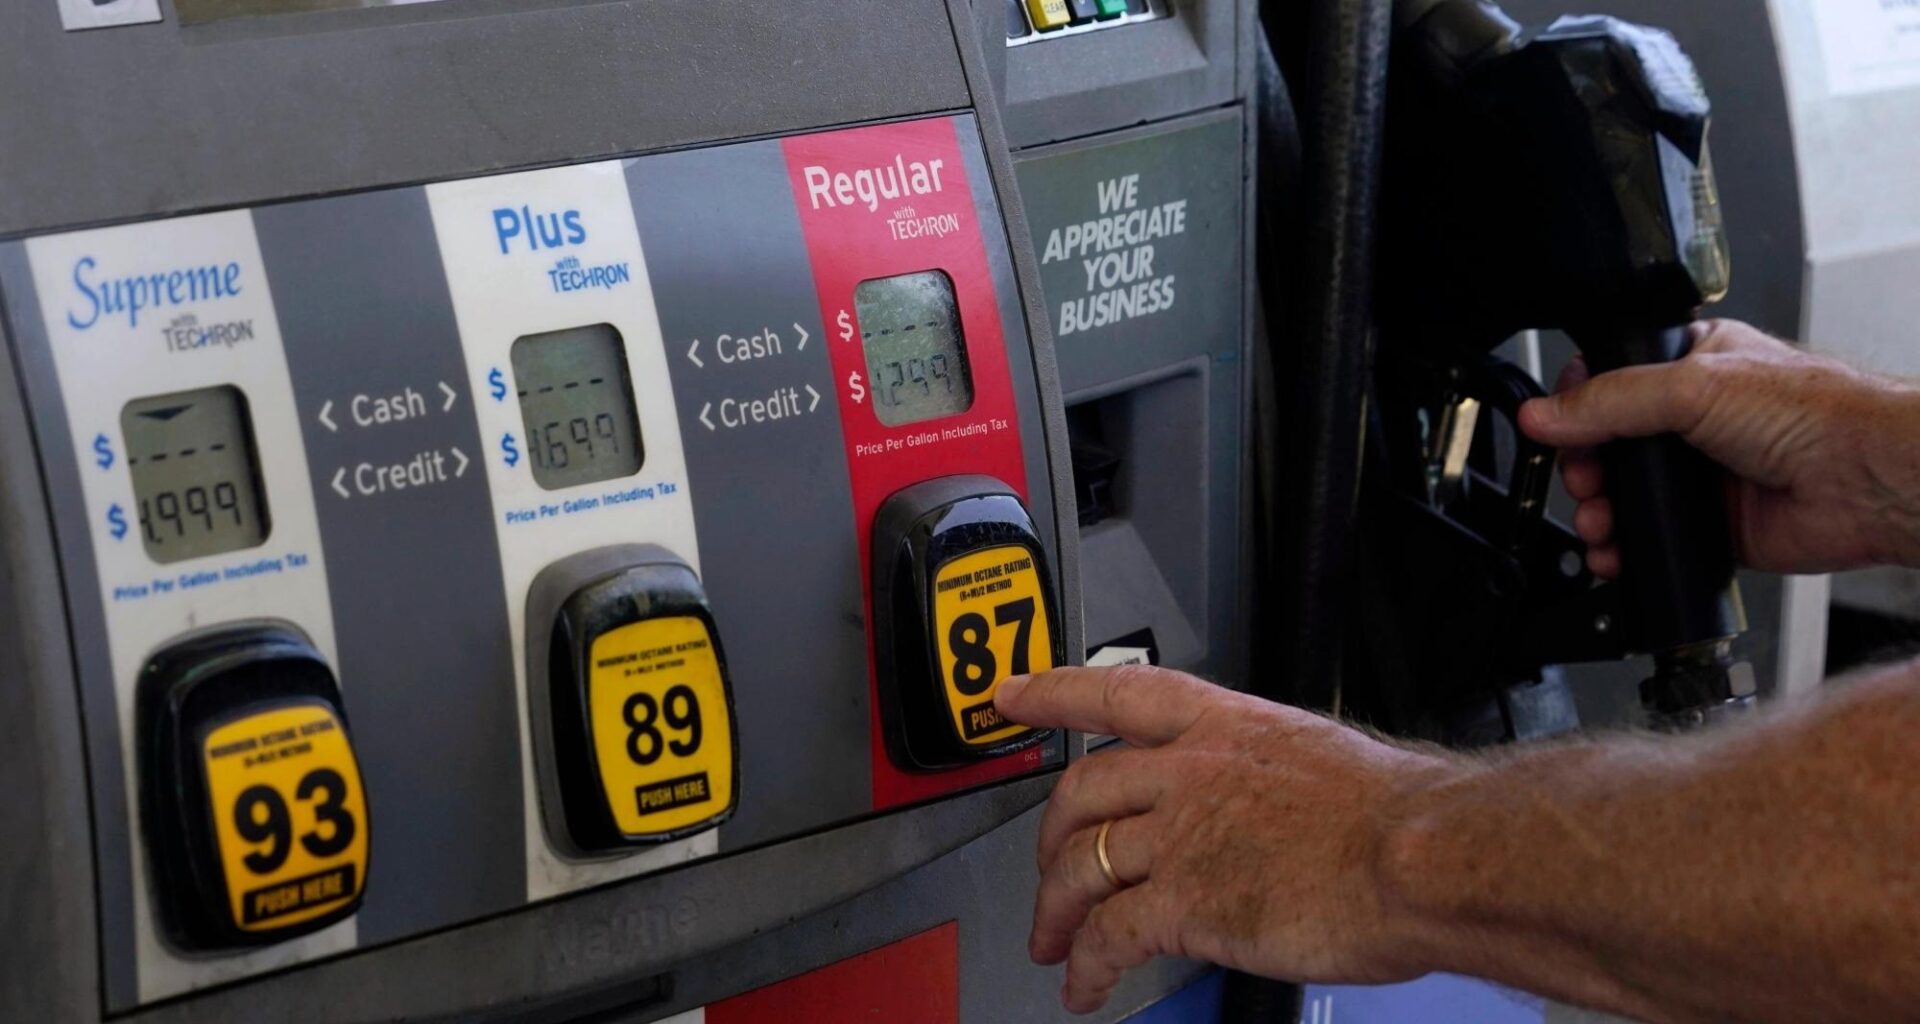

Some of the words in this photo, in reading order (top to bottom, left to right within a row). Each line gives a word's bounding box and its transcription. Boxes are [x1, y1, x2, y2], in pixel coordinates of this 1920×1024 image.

[803, 153, 944, 213] Regular
[1097, 173, 1140, 215] WE
[493, 205, 587, 255] Plus
[887, 212, 960, 241] TECHRON
[894, 206, 917, 220] with
[1041, 199, 1188, 265] APPRECIATE
[548, 263, 630, 293] TECHRON
[555, 256, 581, 271] with
[1082, 245, 1155, 292] YOUR
[68, 256, 242, 330] Supreme
[1058, 275, 1175, 336] BUSINESS
[162, 319, 255, 353] TECHRON
[837, 309, 854, 342] $
[717, 327, 783, 364] Cash
[488, 367, 507, 402] $
[848, 370, 865, 404] $
[351, 388, 427, 427] Cash
[720, 386, 801, 429] Credit
[93, 433, 114, 470] $
[501, 433, 519, 467] $
[856, 441, 884, 457] Price
[886, 437, 904, 452] Per
[906, 431, 939, 449] Gallon
[941, 422, 988, 441] Including
[990, 418, 1009, 431] Tax
[354, 451, 448, 495] Credit
[107, 503, 129, 542] $
[506, 509, 537, 524] Price
[540, 503, 560, 518] Per
[563, 496, 600, 513] Gallon
[602, 485, 654, 507] Including
[657, 482, 676, 495] Tax
[114, 585, 149, 601] Price
[153, 578, 175, 593] Per
[179, 569, 221, 588] Gallon
[224, 557, 283, 580] Including
[286, 552, 309, 567] Tax
[937, 573, 972, 593] MINIMUM
[974, 565, 1002, 583] OCTANE
[1004, 557, 1031, 576] RATING
[987, 578, 1012, 594] METHOD
[949, 597, 1035, 695] 87
[622, 684, 703, 766] 89
[639, 786, 673, 810] PUSH
[675, 779, 707, 802] HERE
[233, 767, 356, 875] 93
